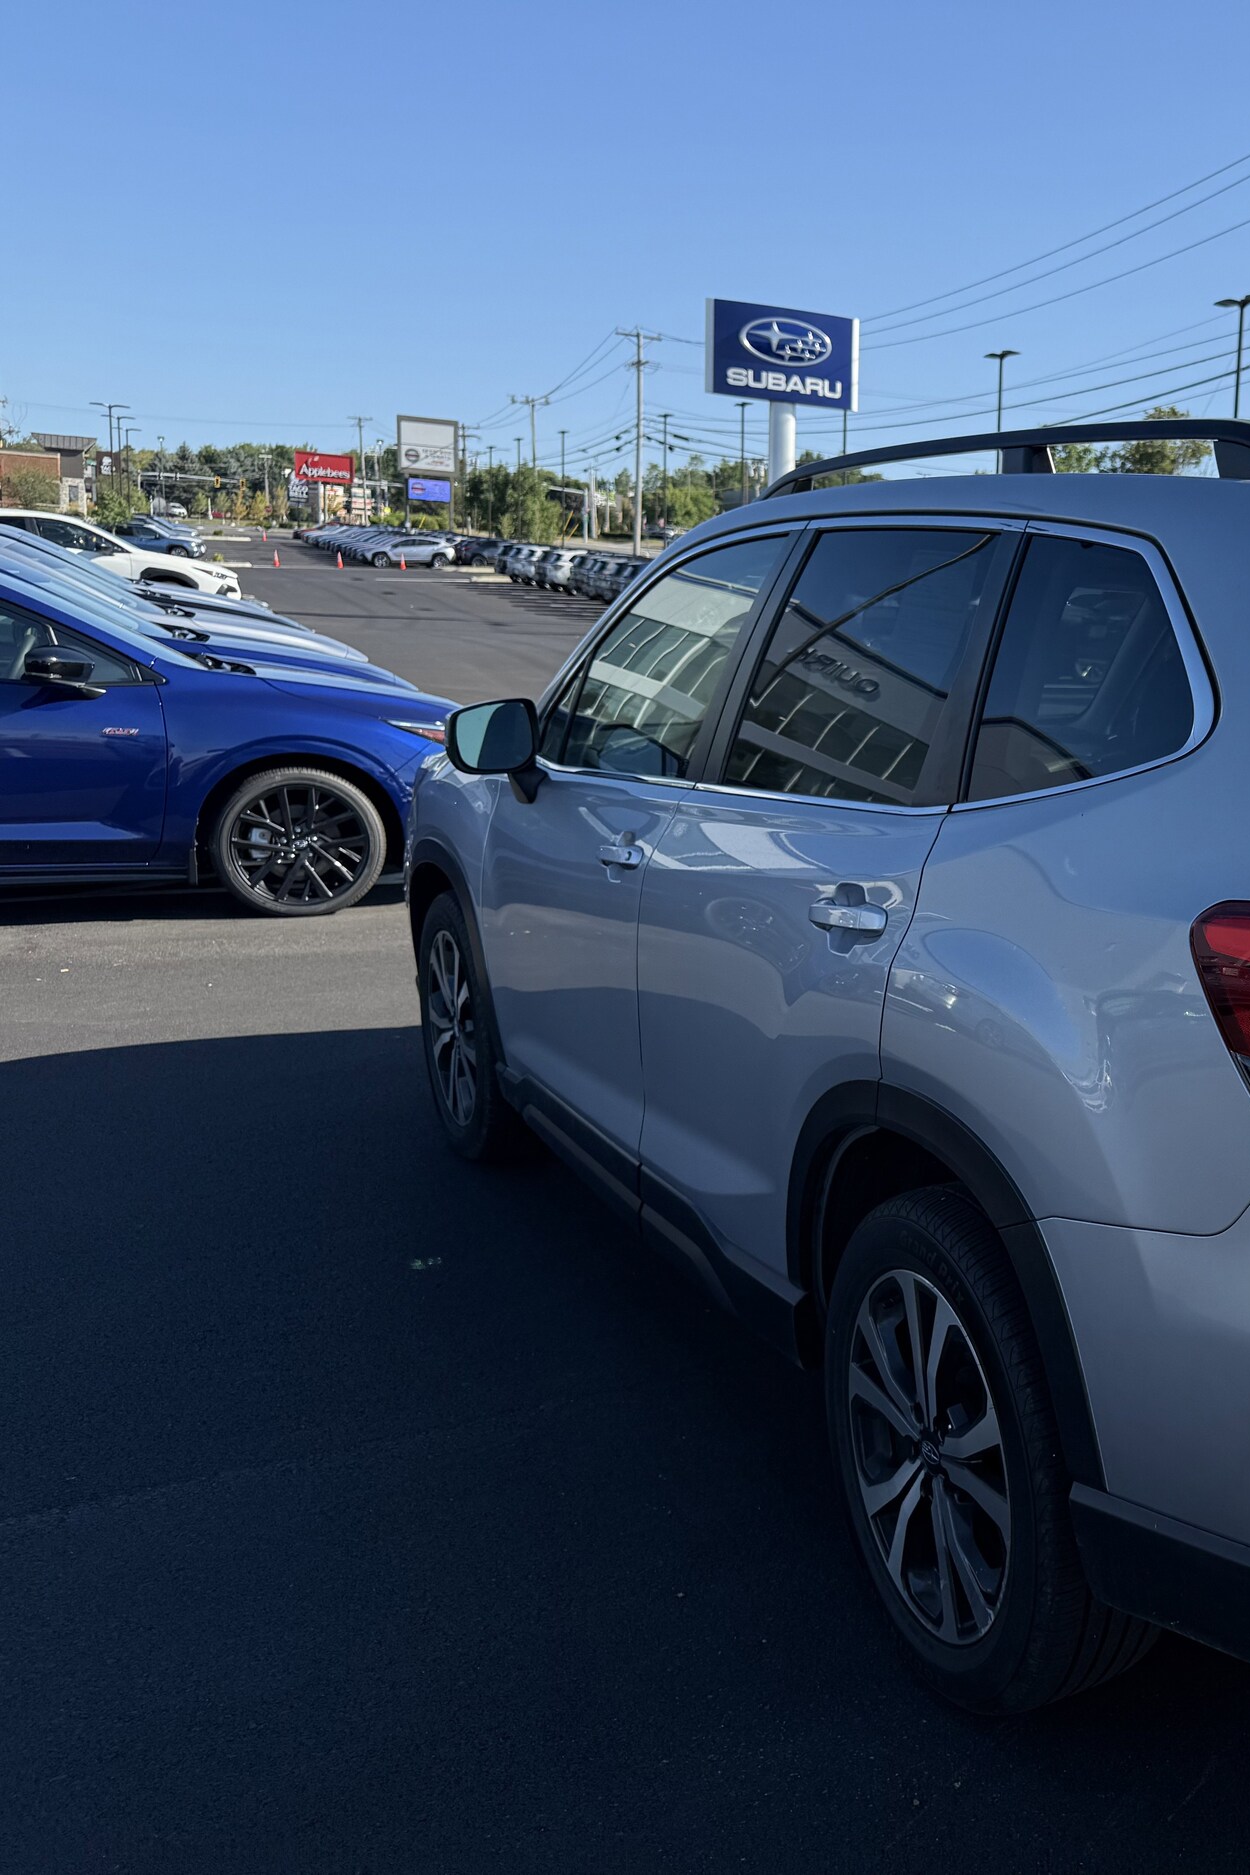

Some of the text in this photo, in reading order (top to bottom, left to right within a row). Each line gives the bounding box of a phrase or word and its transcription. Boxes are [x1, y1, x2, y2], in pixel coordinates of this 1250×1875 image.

[726, 367, 843, 399] SUBARU
[900, 1230, 965, 1306] Grand Prix
